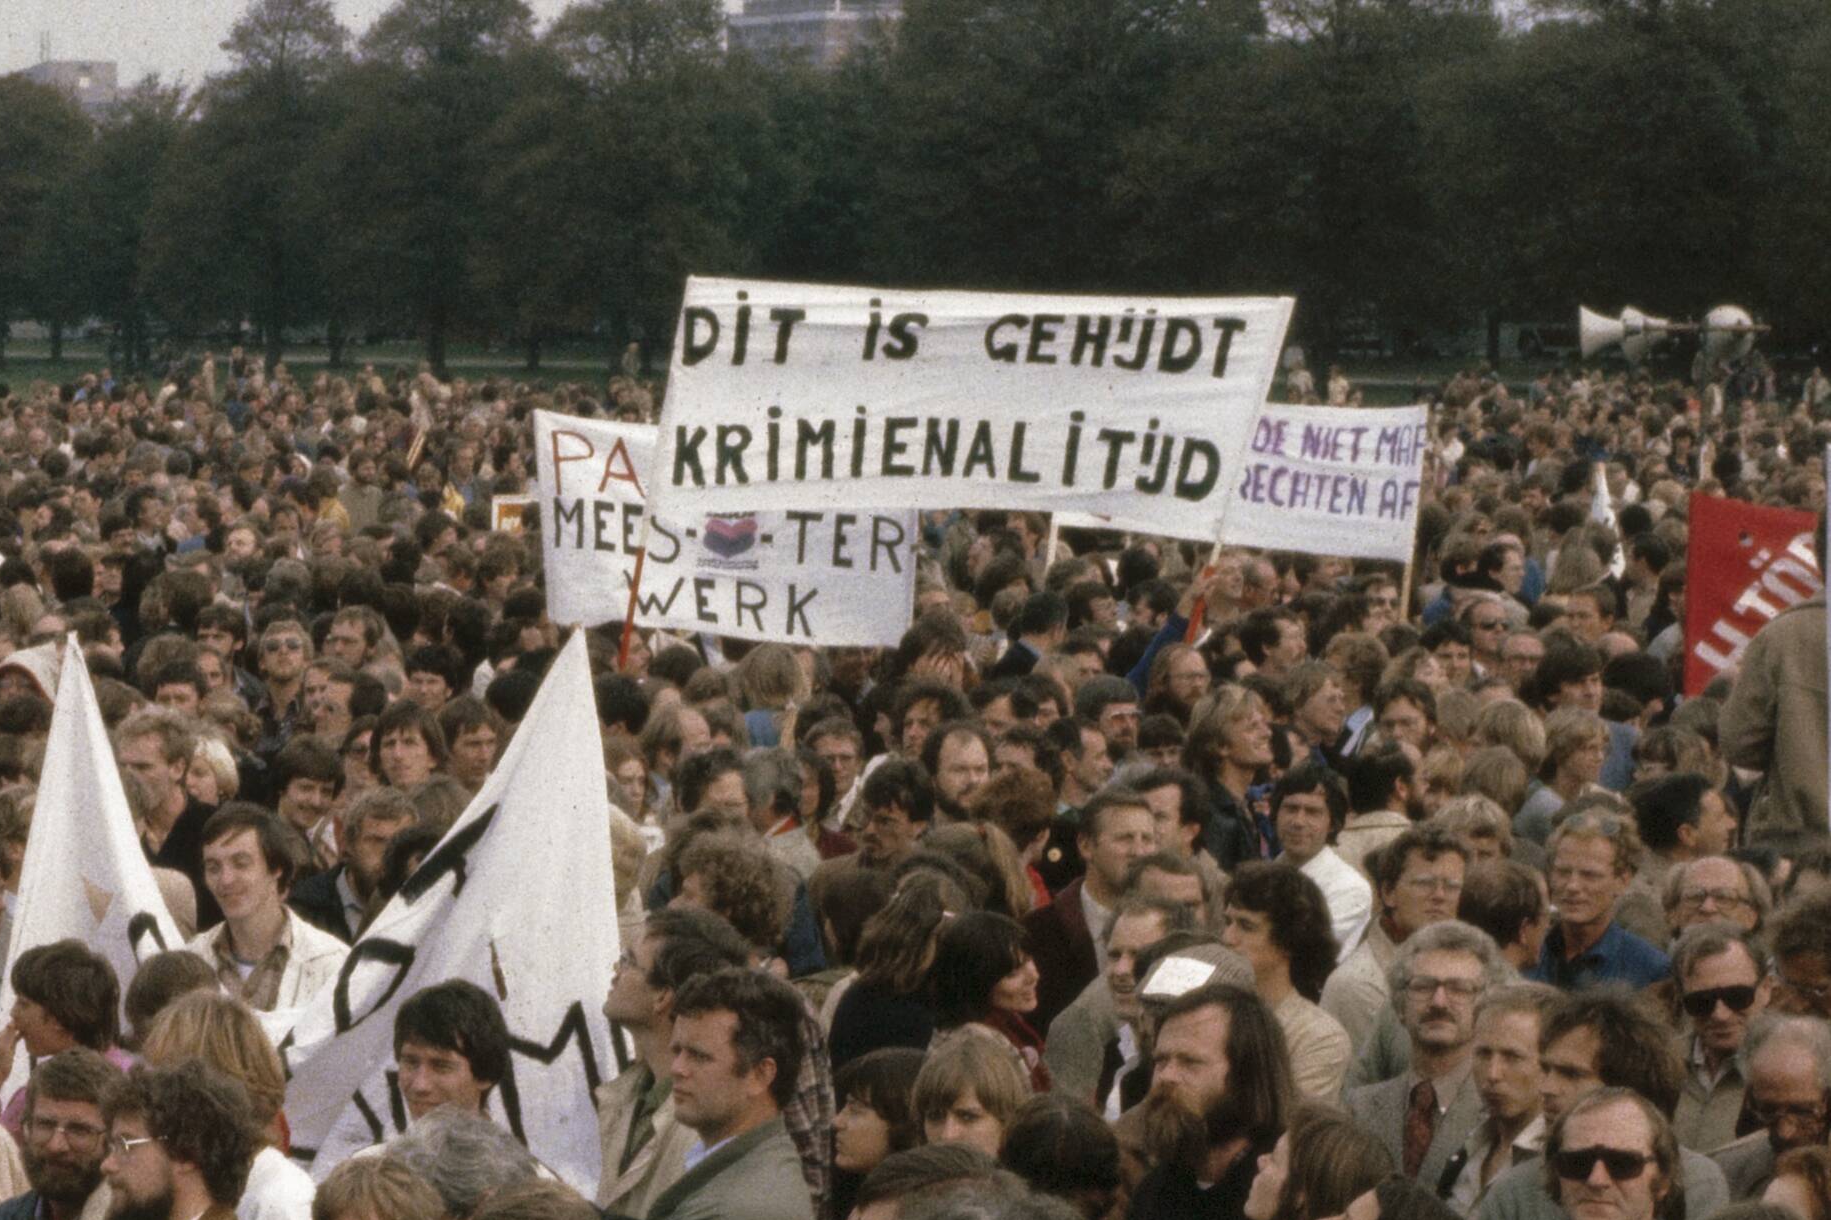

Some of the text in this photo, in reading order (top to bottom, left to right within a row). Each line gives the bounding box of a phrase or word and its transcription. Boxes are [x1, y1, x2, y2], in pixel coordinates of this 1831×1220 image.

[552, 430, 646, 498] PA
[1301, 423, 1369, 463] NIET
[1378, 479, 1419, 520] AF
[623, 569, 818, 637] WERK
